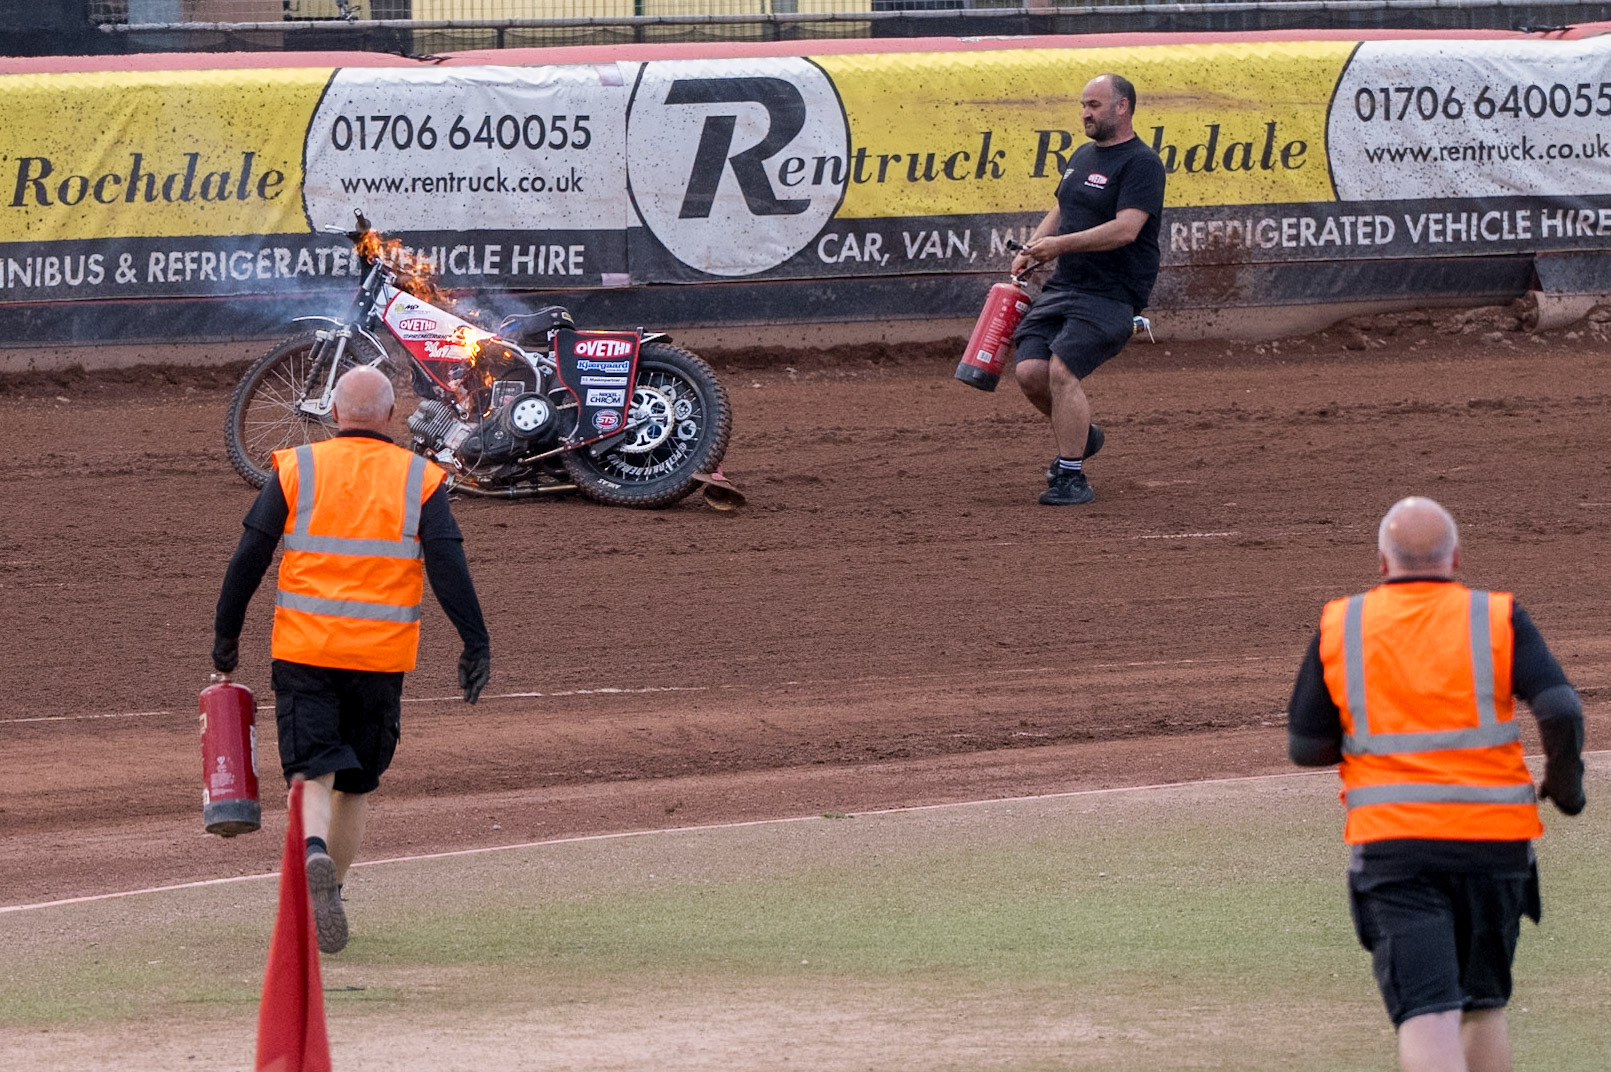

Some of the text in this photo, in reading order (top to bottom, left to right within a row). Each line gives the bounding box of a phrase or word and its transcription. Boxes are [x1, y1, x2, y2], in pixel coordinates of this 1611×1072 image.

[1355, 83, 1611, 122] 01706 640055
[332, 114, 592, 151] 01706 640055
[1029, 121, 1307, 179] Rhdale
[1365, 134, 1611, 164] www.rentruck.co.uk
[10, 151, 285, 207] Rochdale
[340, 166, 584, 194] www.rentruck.co.uk
[1405, 210, 1532, 243] VEHICLE
[1541, 208, 1611, 238] HIRE
[115, 252, 138, 284] &
[511, 244, 585, 276] HIRE
[818, 232, 889, 266] CAR,
[902, 228, 978, 263] VAN,
